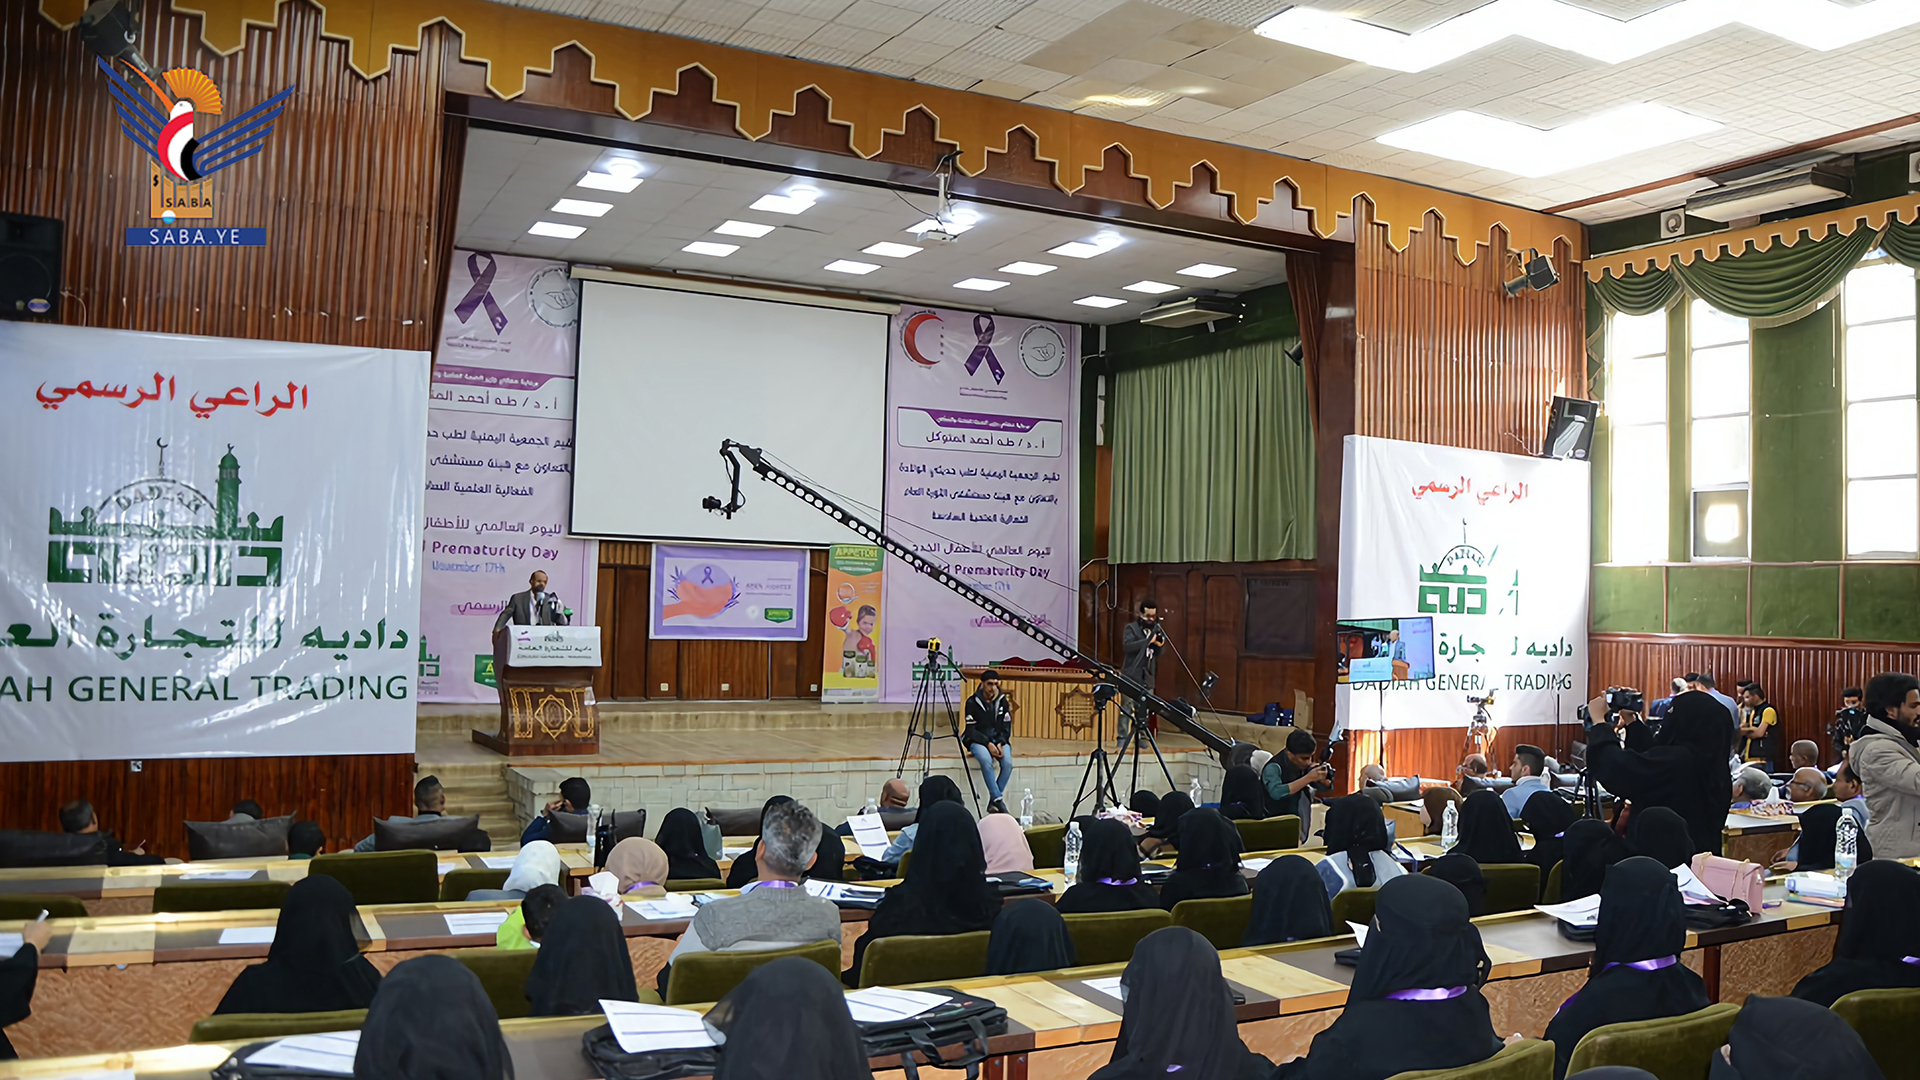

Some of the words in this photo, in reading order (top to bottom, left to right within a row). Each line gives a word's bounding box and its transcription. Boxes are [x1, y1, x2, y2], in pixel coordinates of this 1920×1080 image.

[36, 371, 176, 411] الرسمي
[189, 381, 308, 419] الراعي
[457, 390, 490, 404] أحمد
[495, 396, 517, 407] طه
[969, 432, 994, 446] أحمد
[997, 438, 1015, 447] طه
[1412, 475, 1471, 500] الرسمي
[1476, 481, 1529, 505] الراعي
[475, 521, 525, 535] العالمي
[529, 523, 562, 537] لليوم
[432, 540, 527, 560] Prematurity
[531, 545, 559, 561] Day
[301, 616, 409, 662] داديه
[1525, 636, 1574, 665] داديه
[68, 675, 239, 702] GENERAL
[250, 674, 408, 702] TRADING
[1504, 673, 1573, 690] TRADING
